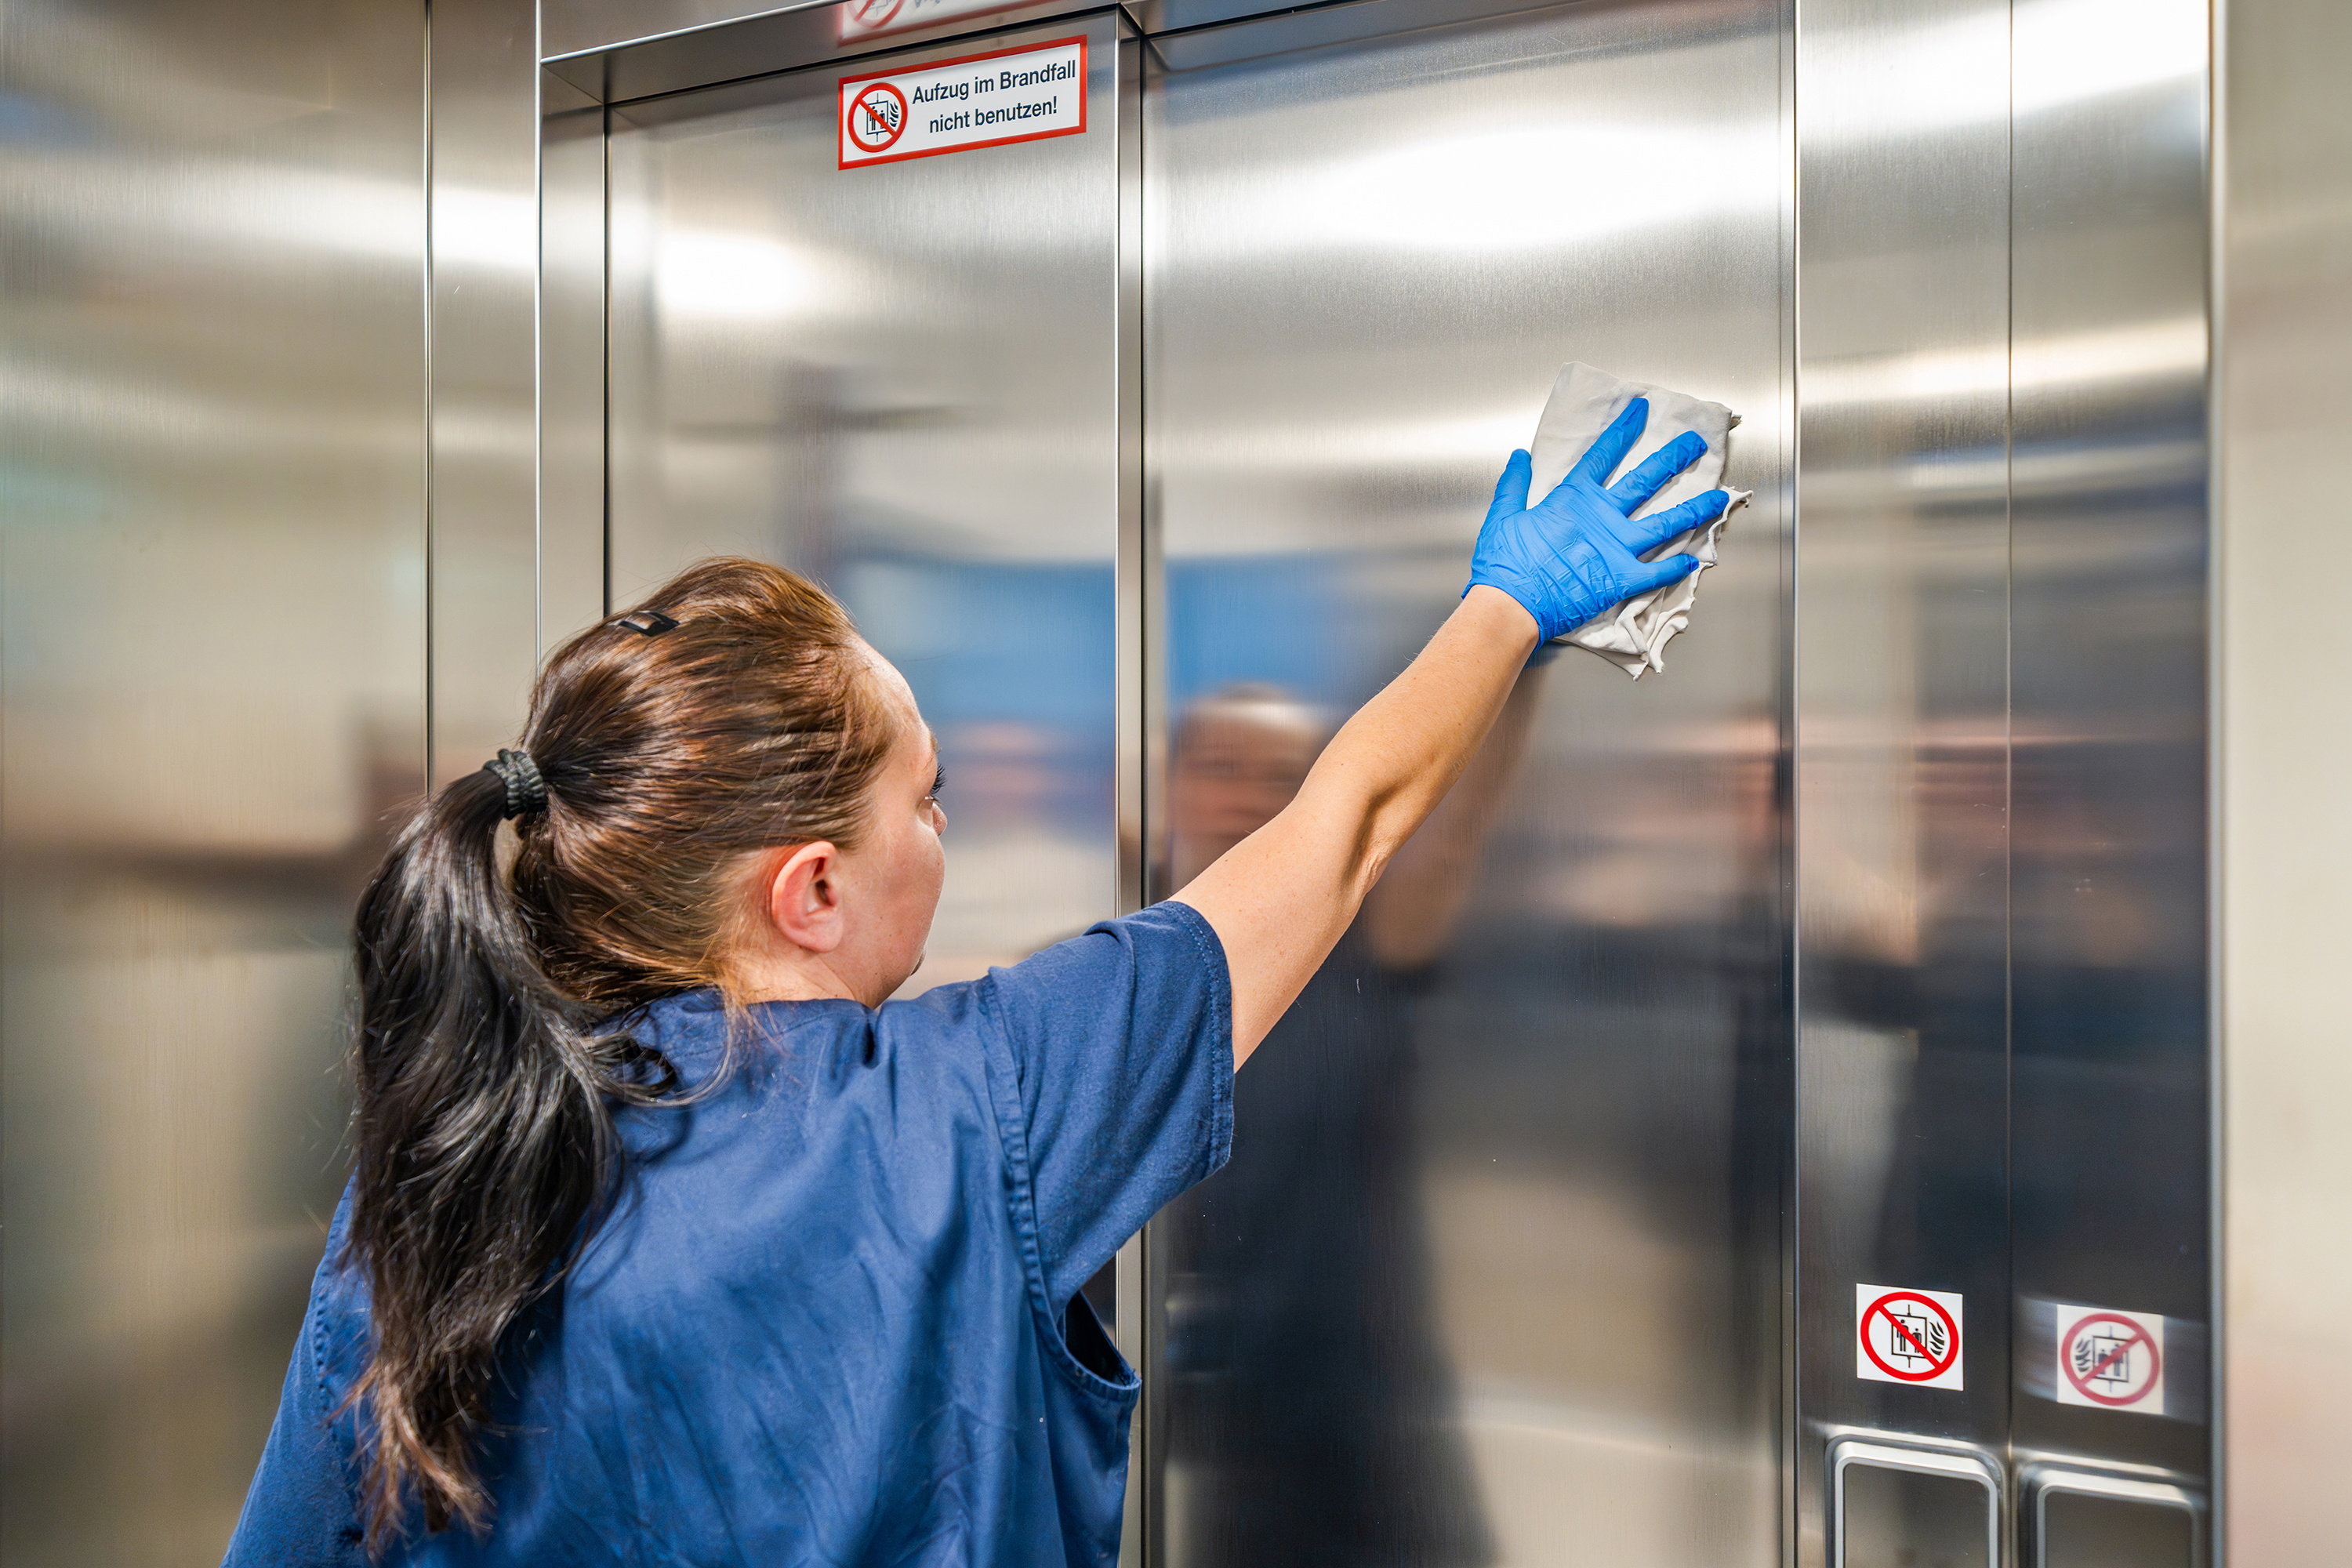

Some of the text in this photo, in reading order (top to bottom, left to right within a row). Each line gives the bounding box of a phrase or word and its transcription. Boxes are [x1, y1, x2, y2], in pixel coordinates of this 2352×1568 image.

[912, 60, 1076, 104] Aufzug im Brandfall
[929, 96, 1058, 134] nicht benutzen!
